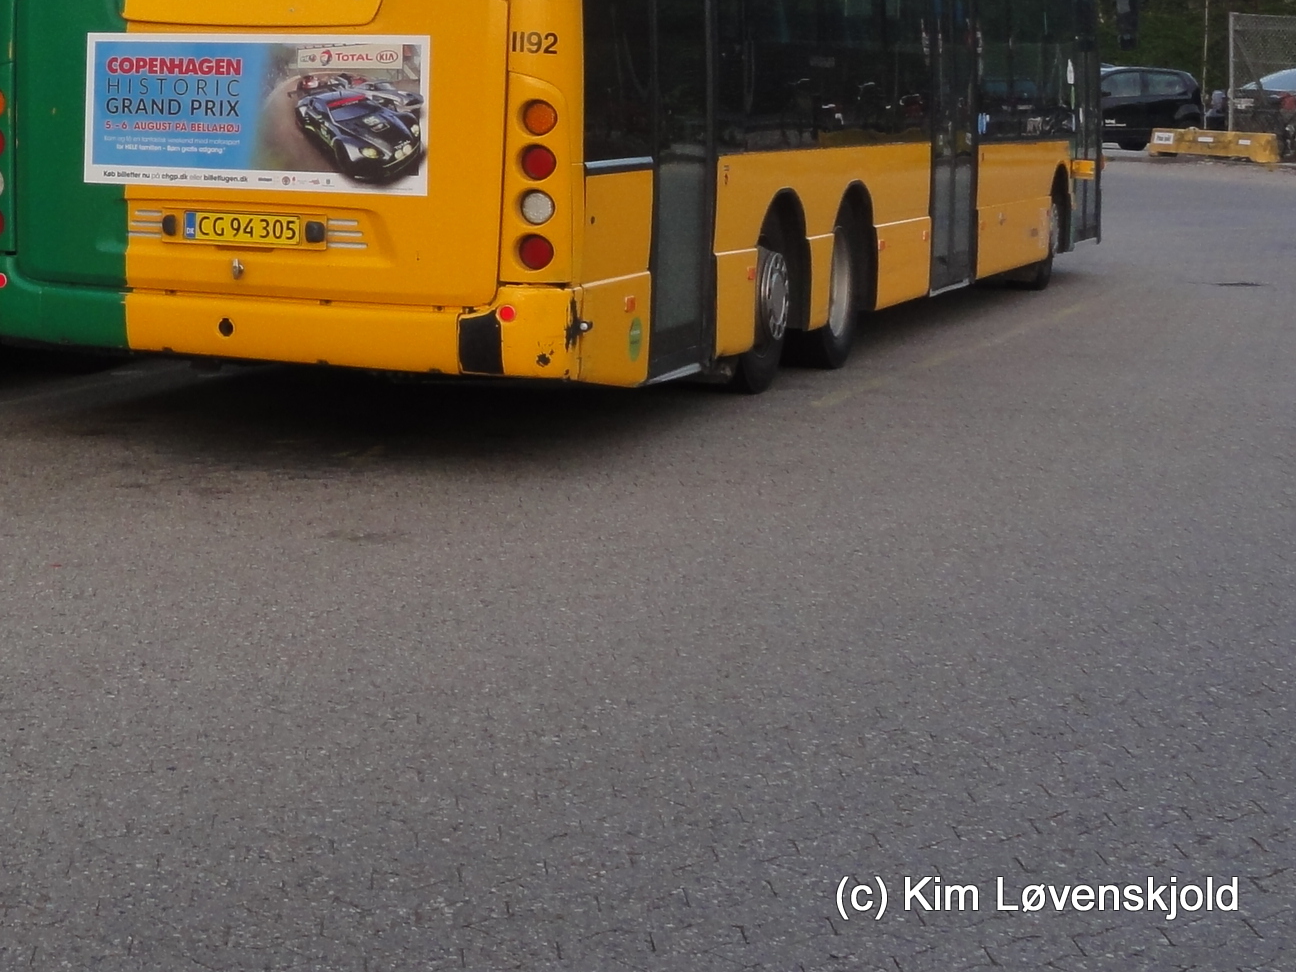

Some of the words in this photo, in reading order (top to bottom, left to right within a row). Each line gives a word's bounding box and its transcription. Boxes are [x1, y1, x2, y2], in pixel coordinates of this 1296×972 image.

[511, 31, 558, 54] 1192
[106, 56, 242, 76] COPENHAGEN
[335, 53, 373, 62] TOTAL
[107, 77, 240, 97] HISTORIC
[106, 97, 181, 115] GRAND
[190, 99, 239, 117] PRIX
[134, 121, 171, 132] AUGUST
[190, 123, 240, 133] BELLAHØJ
[116, 170, 141, 178] billetter
[199, 216, 225, 237] CG
[230, 217, 253, 238] 94
[259, 219, 296, 240] 305
